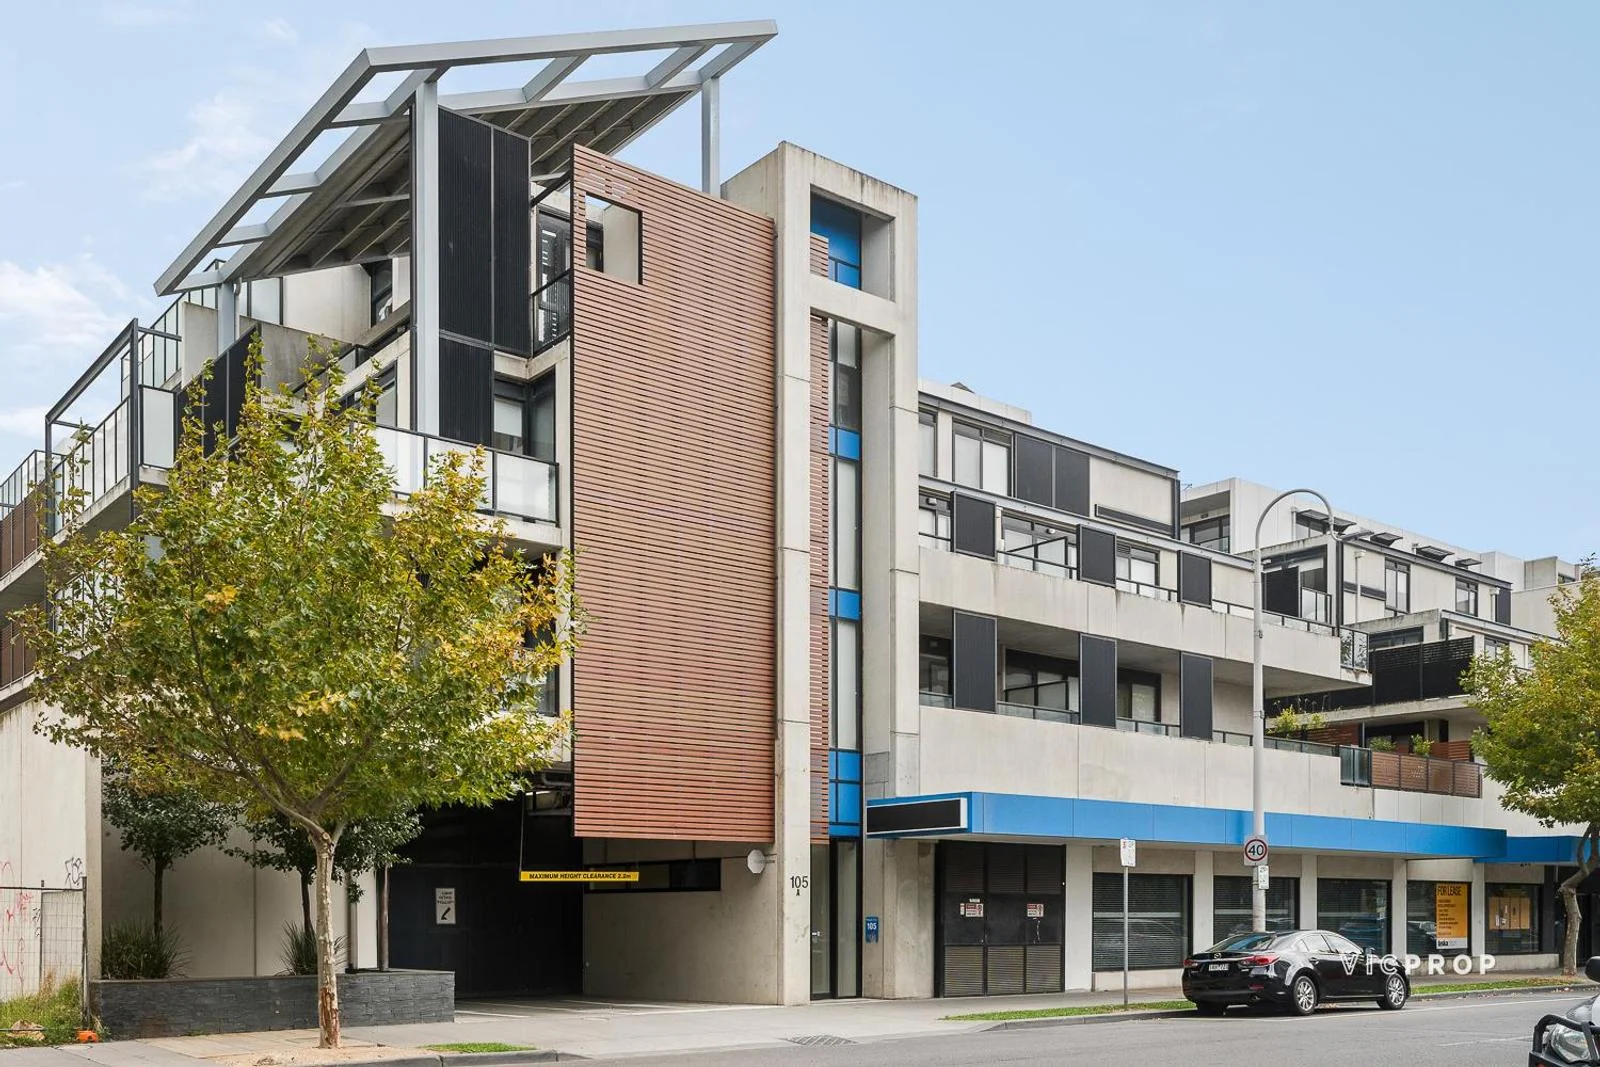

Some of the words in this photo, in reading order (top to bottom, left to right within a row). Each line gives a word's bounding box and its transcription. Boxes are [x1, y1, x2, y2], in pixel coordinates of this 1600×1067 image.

[1248, 845, 1264, 856] 40
[790, 876, 808, 888] 105
[1437, 886, 1447, 896] FOR
[1448, 886, 1462, 896] LEASE
[867, 922, 877, 930] 105
